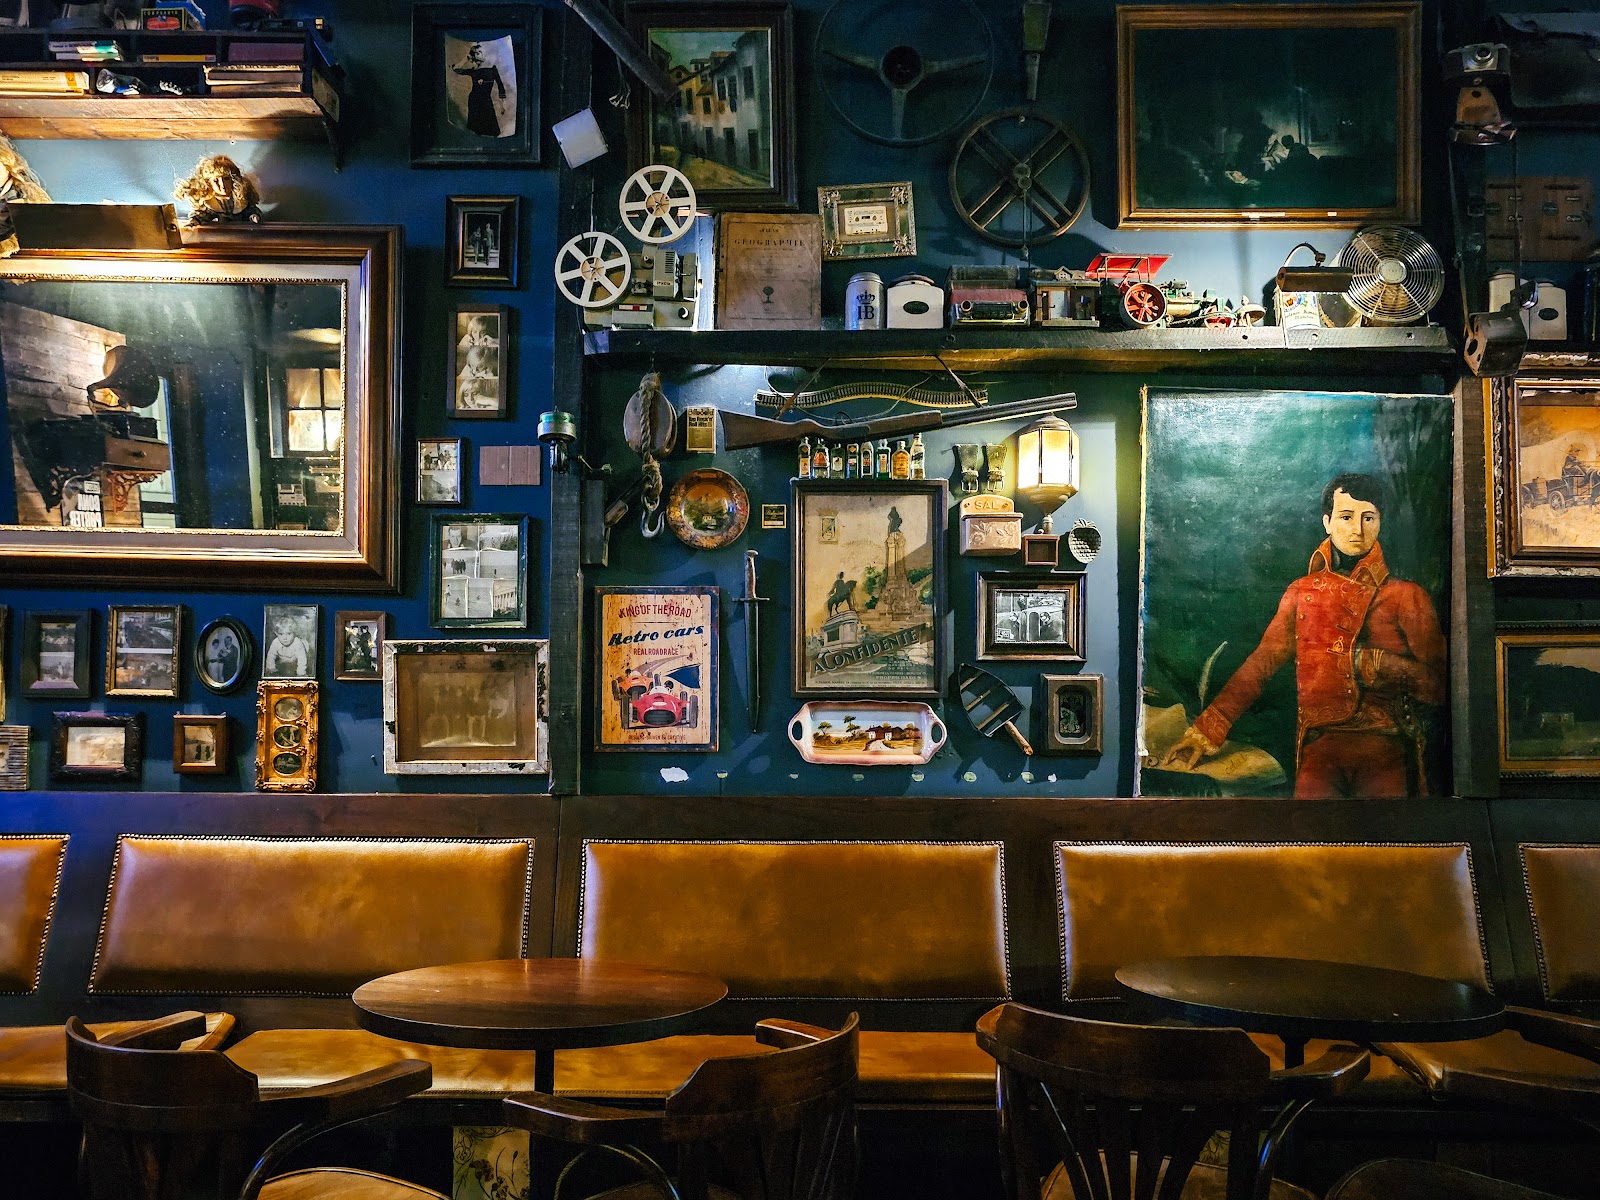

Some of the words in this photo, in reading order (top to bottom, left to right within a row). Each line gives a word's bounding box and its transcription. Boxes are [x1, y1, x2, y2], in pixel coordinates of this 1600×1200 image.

[974, 500, 999, 510] SAL
[619, 604, 640, 618] KING
[640, 604, 652, 615] OF
[653, 604, 669, 615] THE
[668, 605, 692, 618] ROAD
[608, 629, 659, 647] Retro
[663, 625, 704, 639] cars
[633, 647, 648, 656] REAL
[648, 647, 679, 656] ROADRACE
